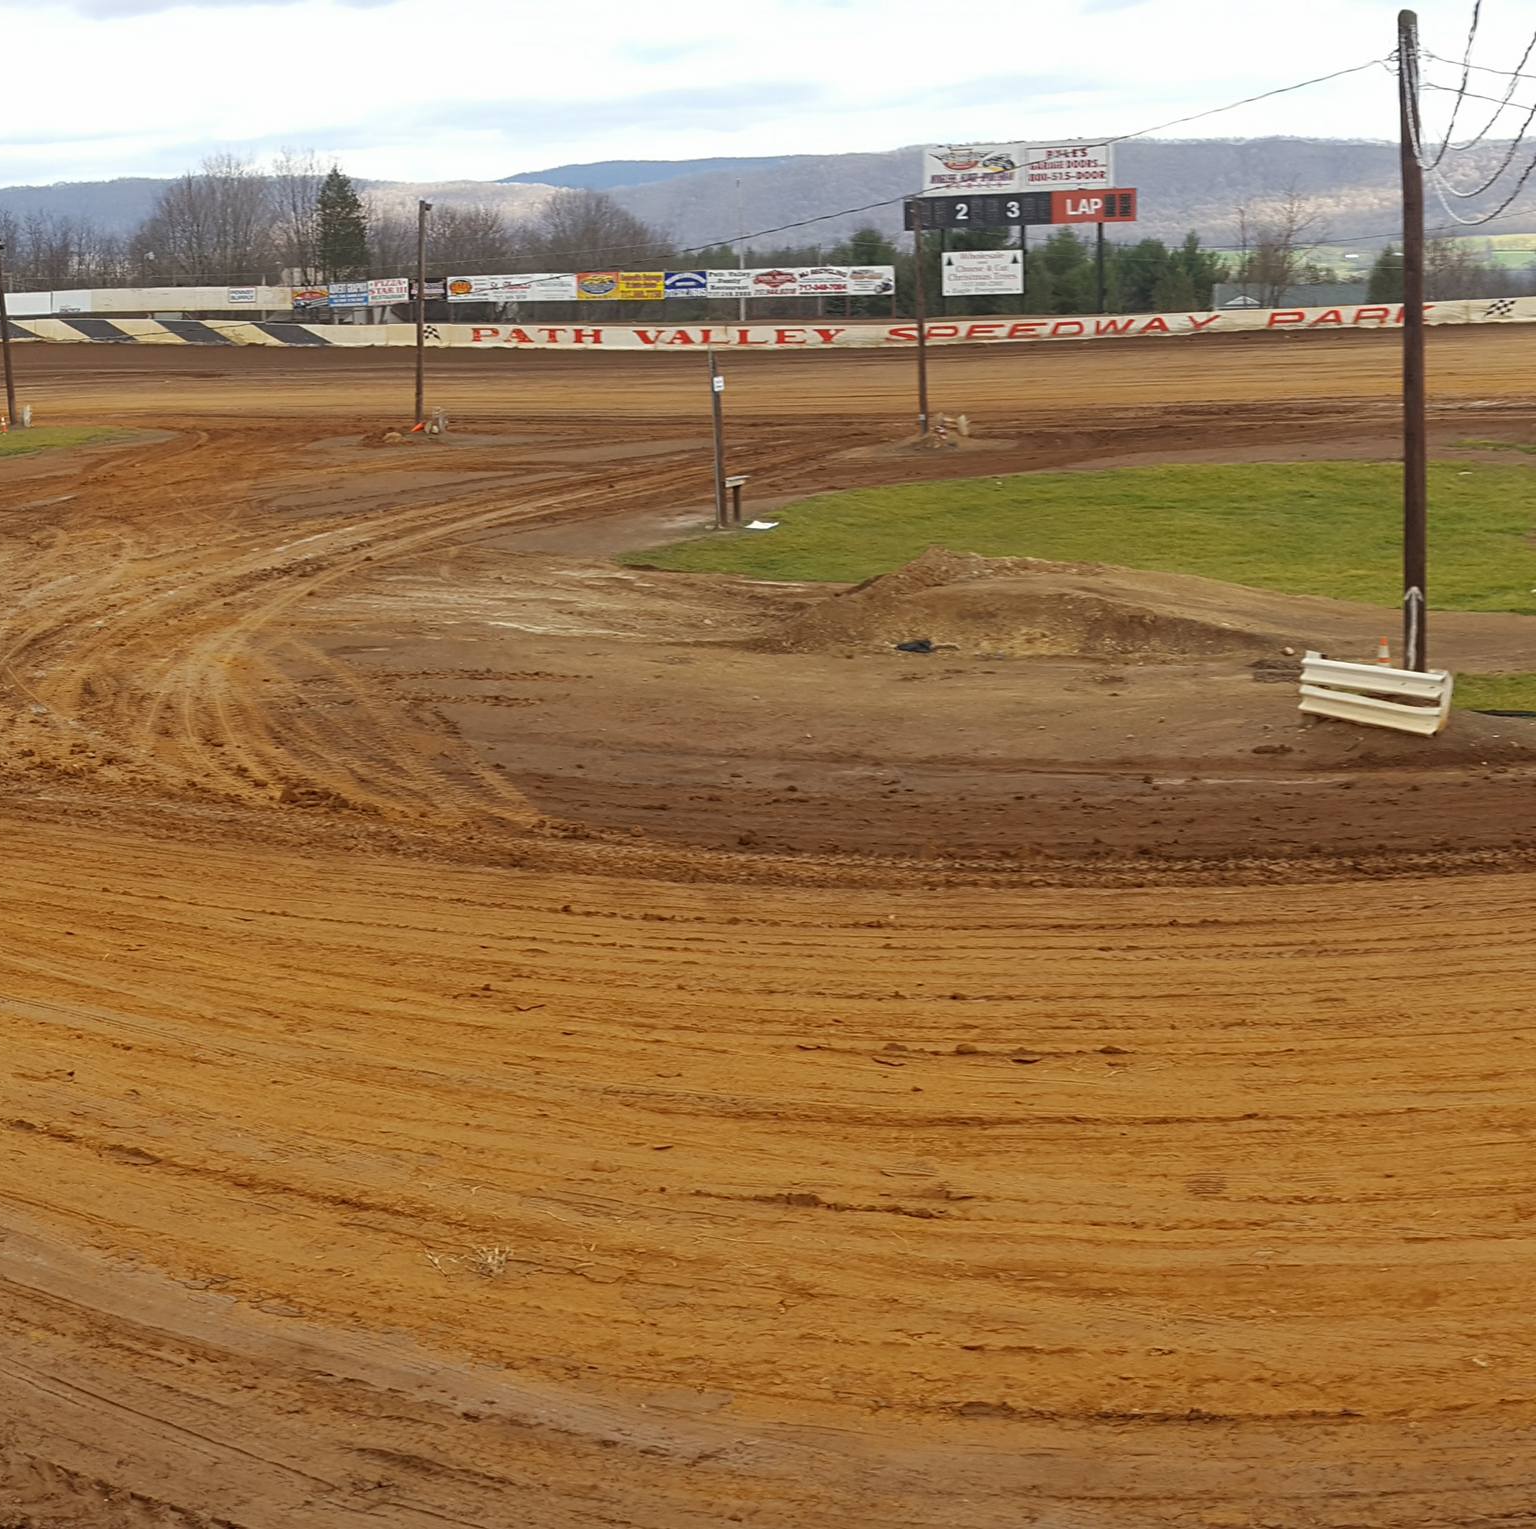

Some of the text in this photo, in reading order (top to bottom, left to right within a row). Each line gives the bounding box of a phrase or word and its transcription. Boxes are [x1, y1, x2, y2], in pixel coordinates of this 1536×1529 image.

[955, 198, 1103, 219] 2 3 LAP
[368, 286, 395, 295] STAR
[374, 279, 403, 287] PIZZA
[470, 327, 603, 344] PATH
[632, 328, 847, 345] VALLEY
[886, 315, 1221, 342] SPEEDWAY
